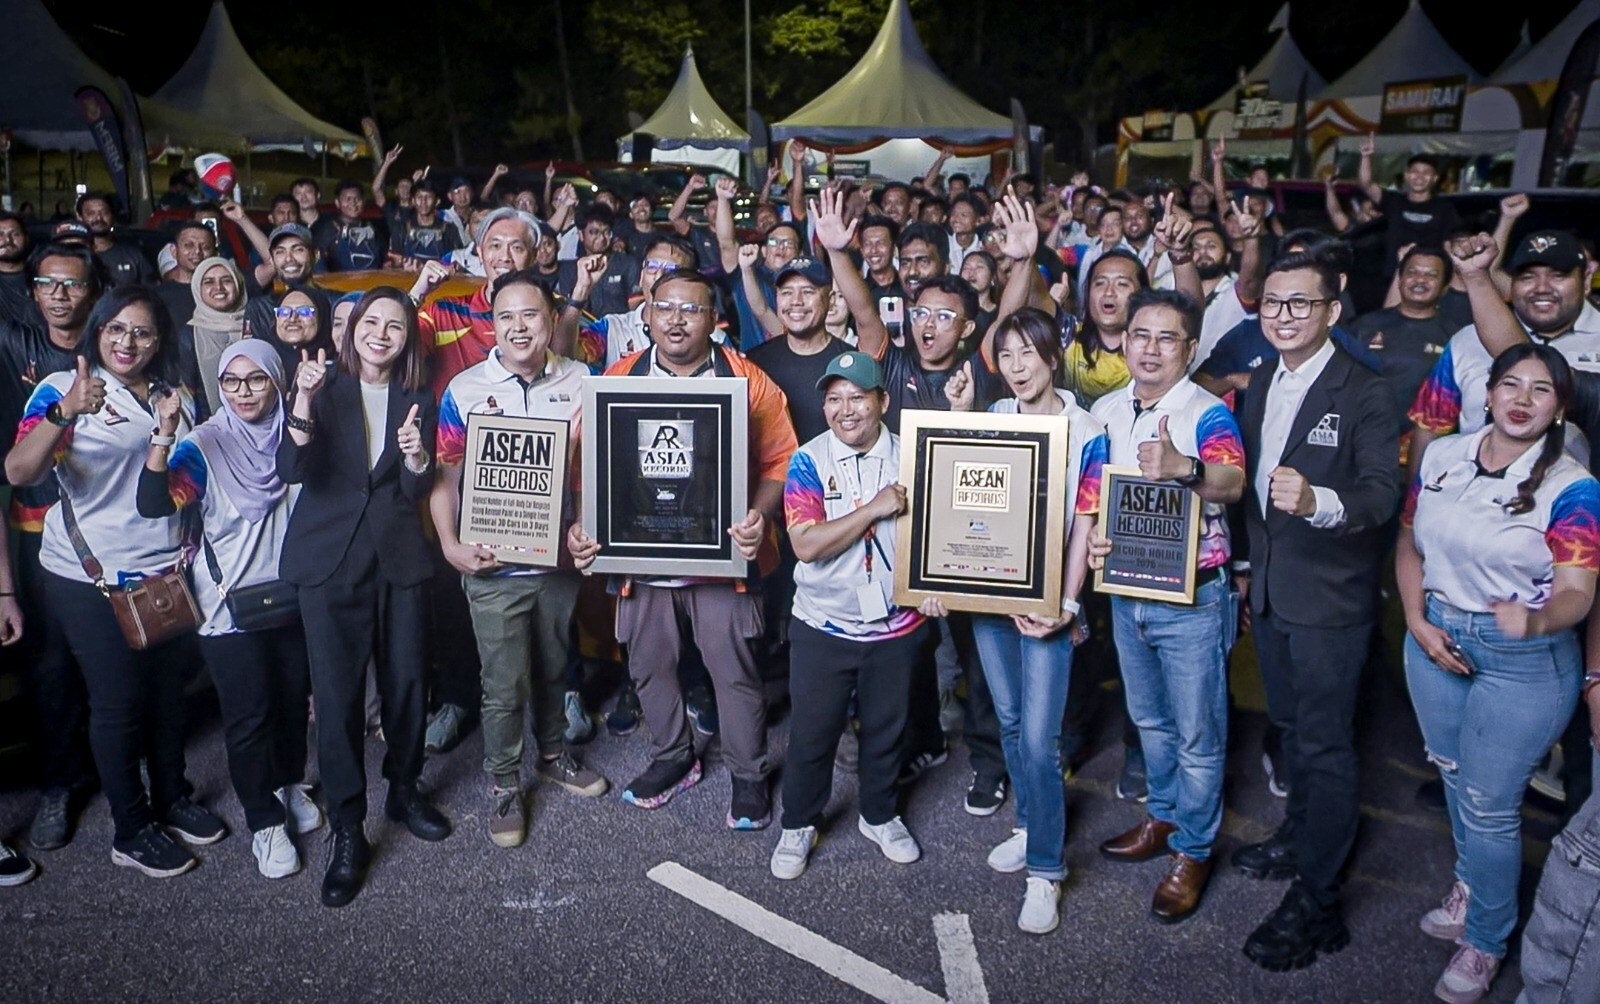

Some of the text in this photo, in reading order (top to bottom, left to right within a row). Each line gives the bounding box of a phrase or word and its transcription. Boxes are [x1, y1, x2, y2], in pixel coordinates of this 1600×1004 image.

[480, 431, 552, 467] ASEAN
[644, 451, 687, 465] ASIA
[643, 465, 689, 473] RECORDS
[959, 469, 1004, 489] ASEAN
[478, 467, 549, 492] RECORDS
[958, 491, 1004, 506] RECORDS
[1120, 484, 1183, 516] ASEAN
[471, 516, 497, 526] Samurai
[498, 518, 506, 527] 30
[507, 519, 521, 528] Cars
[529, 521, 534, 529] 3
[534, 522, 549, 532] Days
[1117, 515, 1181, 538] RECORDS
